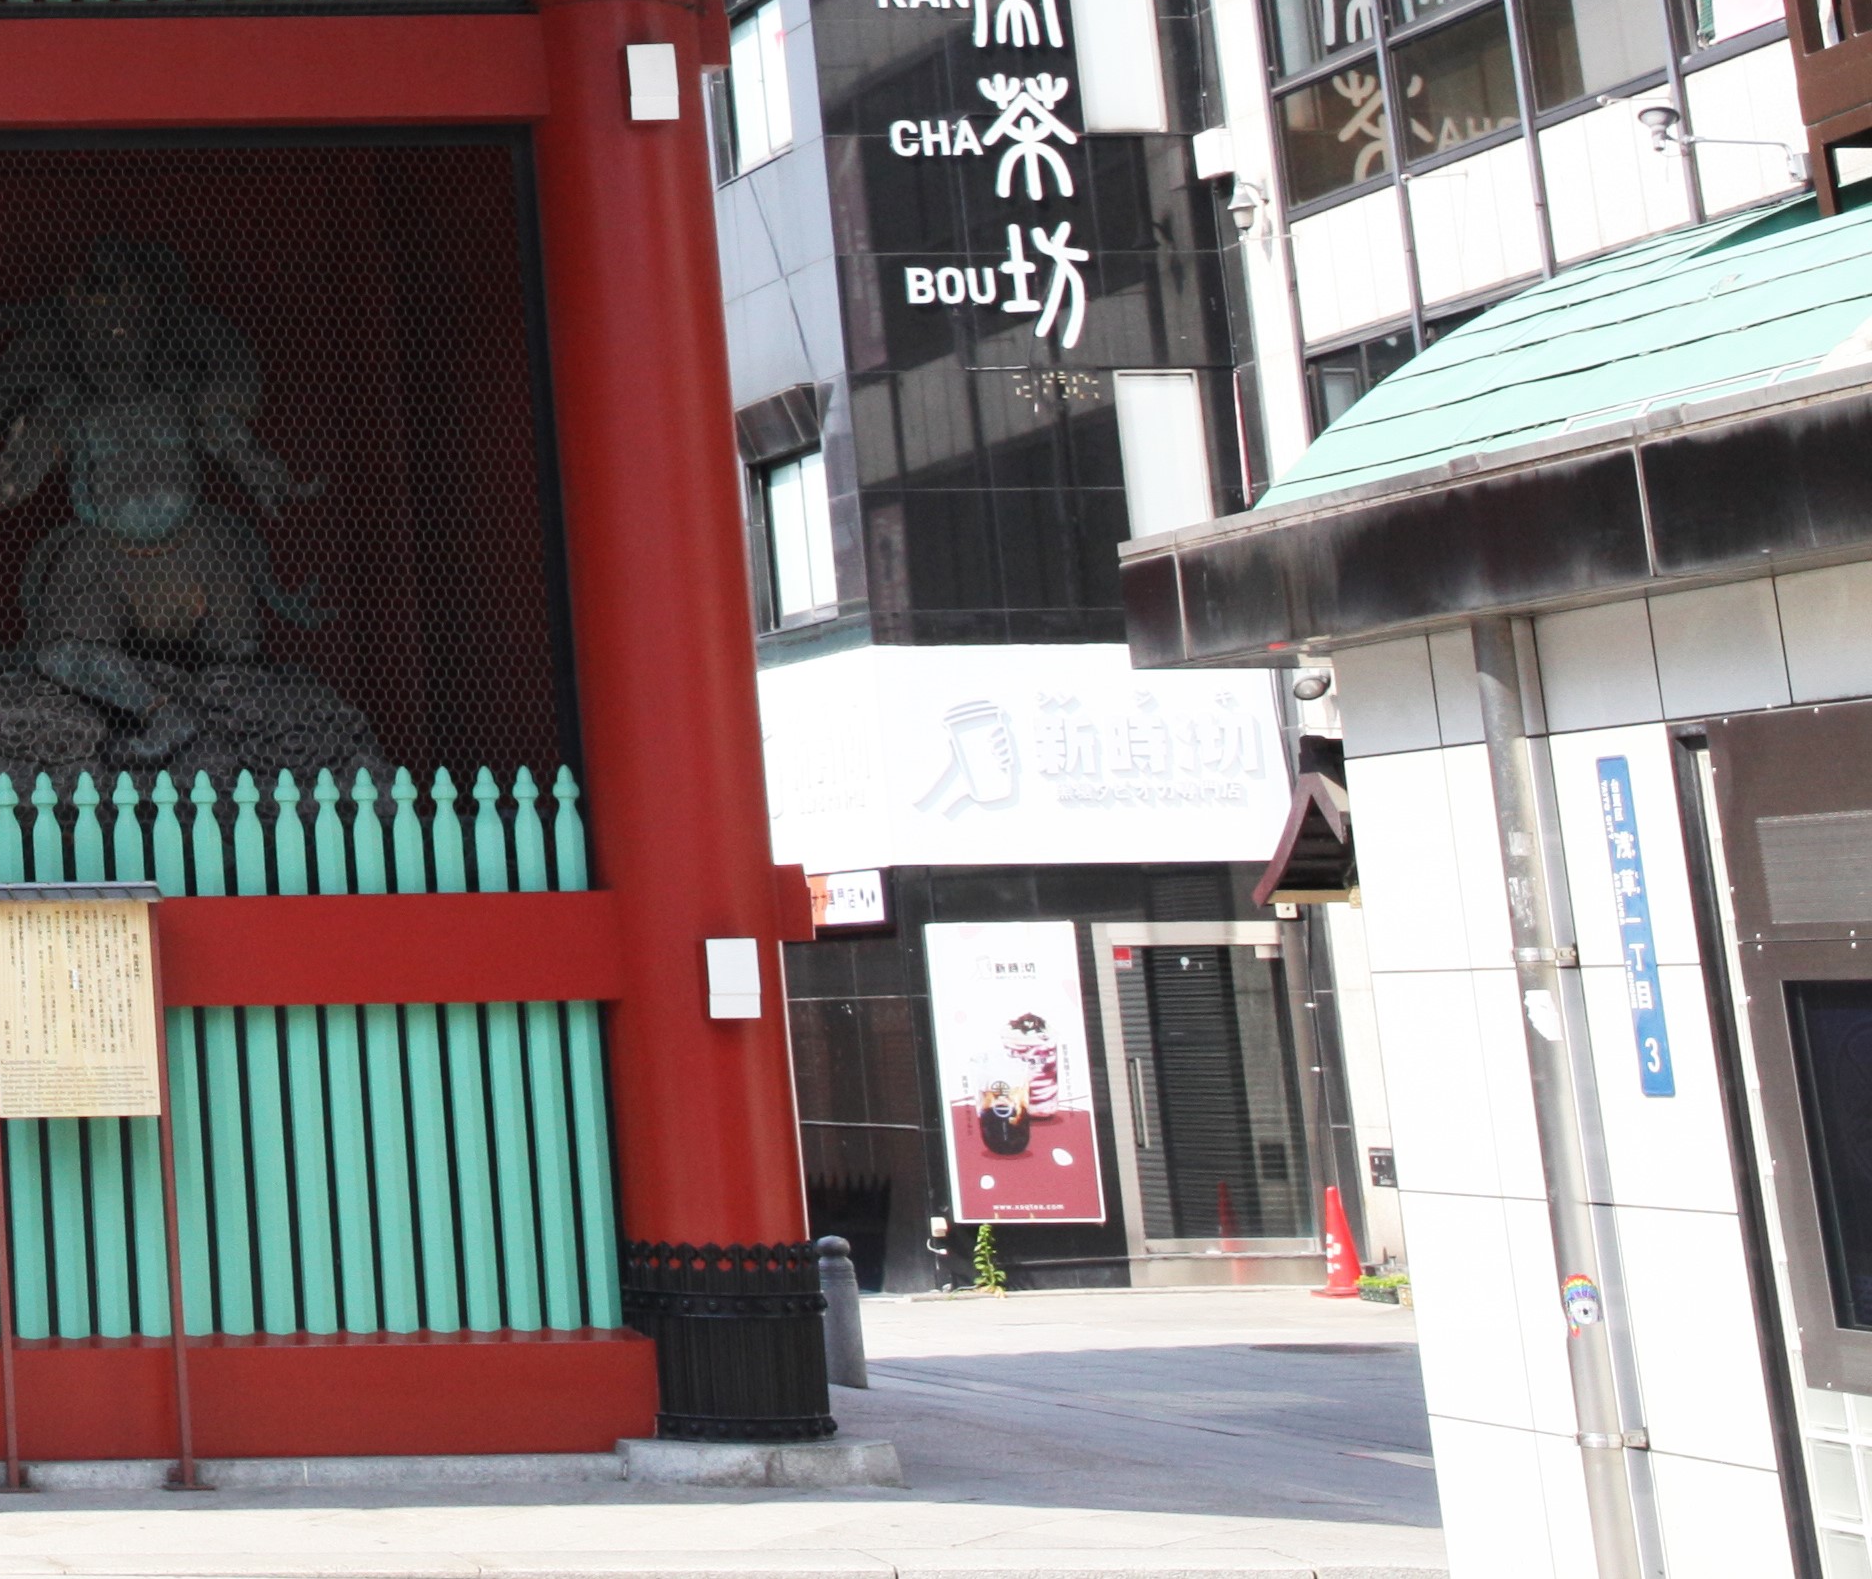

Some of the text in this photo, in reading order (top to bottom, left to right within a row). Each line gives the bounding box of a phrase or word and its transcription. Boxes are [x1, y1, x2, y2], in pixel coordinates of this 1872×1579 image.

[889, 119, 985, 157] CHA
[904, 266, 997, 306] BOU
[1644, 1037, 1661, 1073] 3
